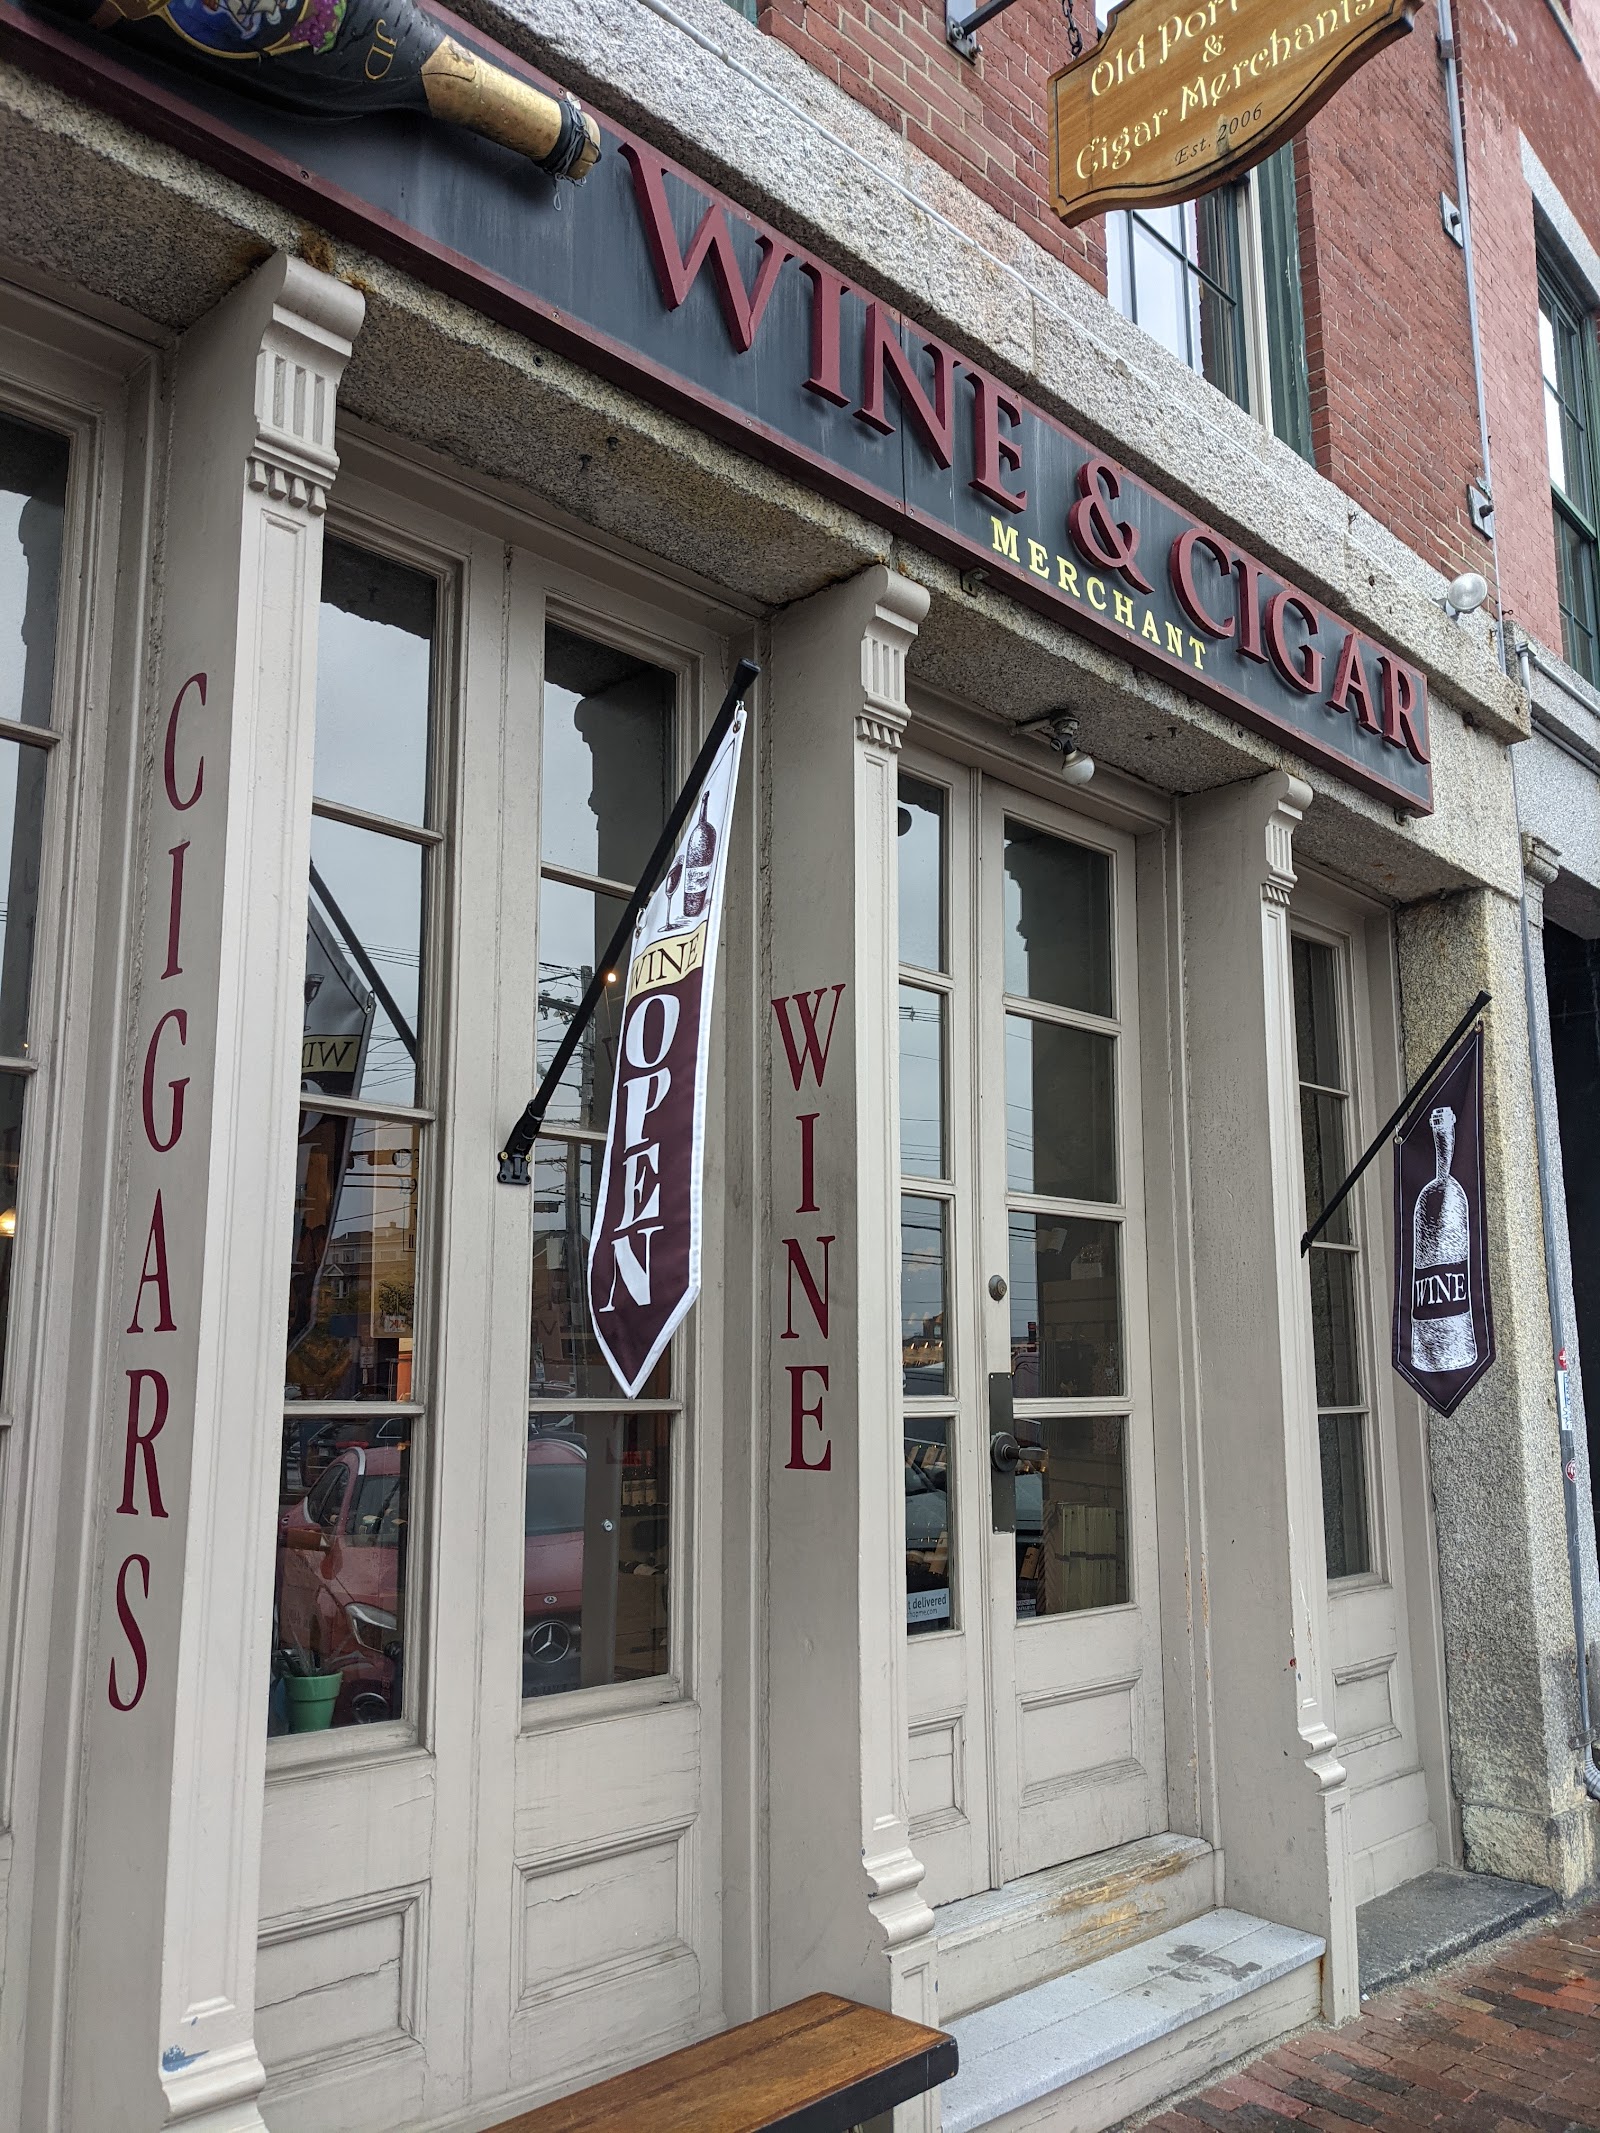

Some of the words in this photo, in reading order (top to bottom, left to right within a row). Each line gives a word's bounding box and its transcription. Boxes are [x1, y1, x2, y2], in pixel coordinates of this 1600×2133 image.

[1076, 107, 1170, 181] Cigar
[1179, 0, 1376, 122] Merchants
[1091, 34, 1146, 97] Old
[1202, 33, 1227, 64] &
[1174, 142, 1212, 167] Est.
[1216, 102, 1264, 142] 2006
[618, 141, 1028, 515] WINE
[1068, 457, 1156, 595] &
[1170, 526, 1432, 765] CIGAR
[990, 515, 1208, 671] MERCHANT
[631, 933, 700, 989] WINE
[108, 672, 208, 1713] CIGARS
[598, 993, 681, 1313] OPEN
[771, 983, 847, 1472] WINE
[1415, 1272, 1467, 1307] WINE
[912, 1593, 947, 1610] delivered
